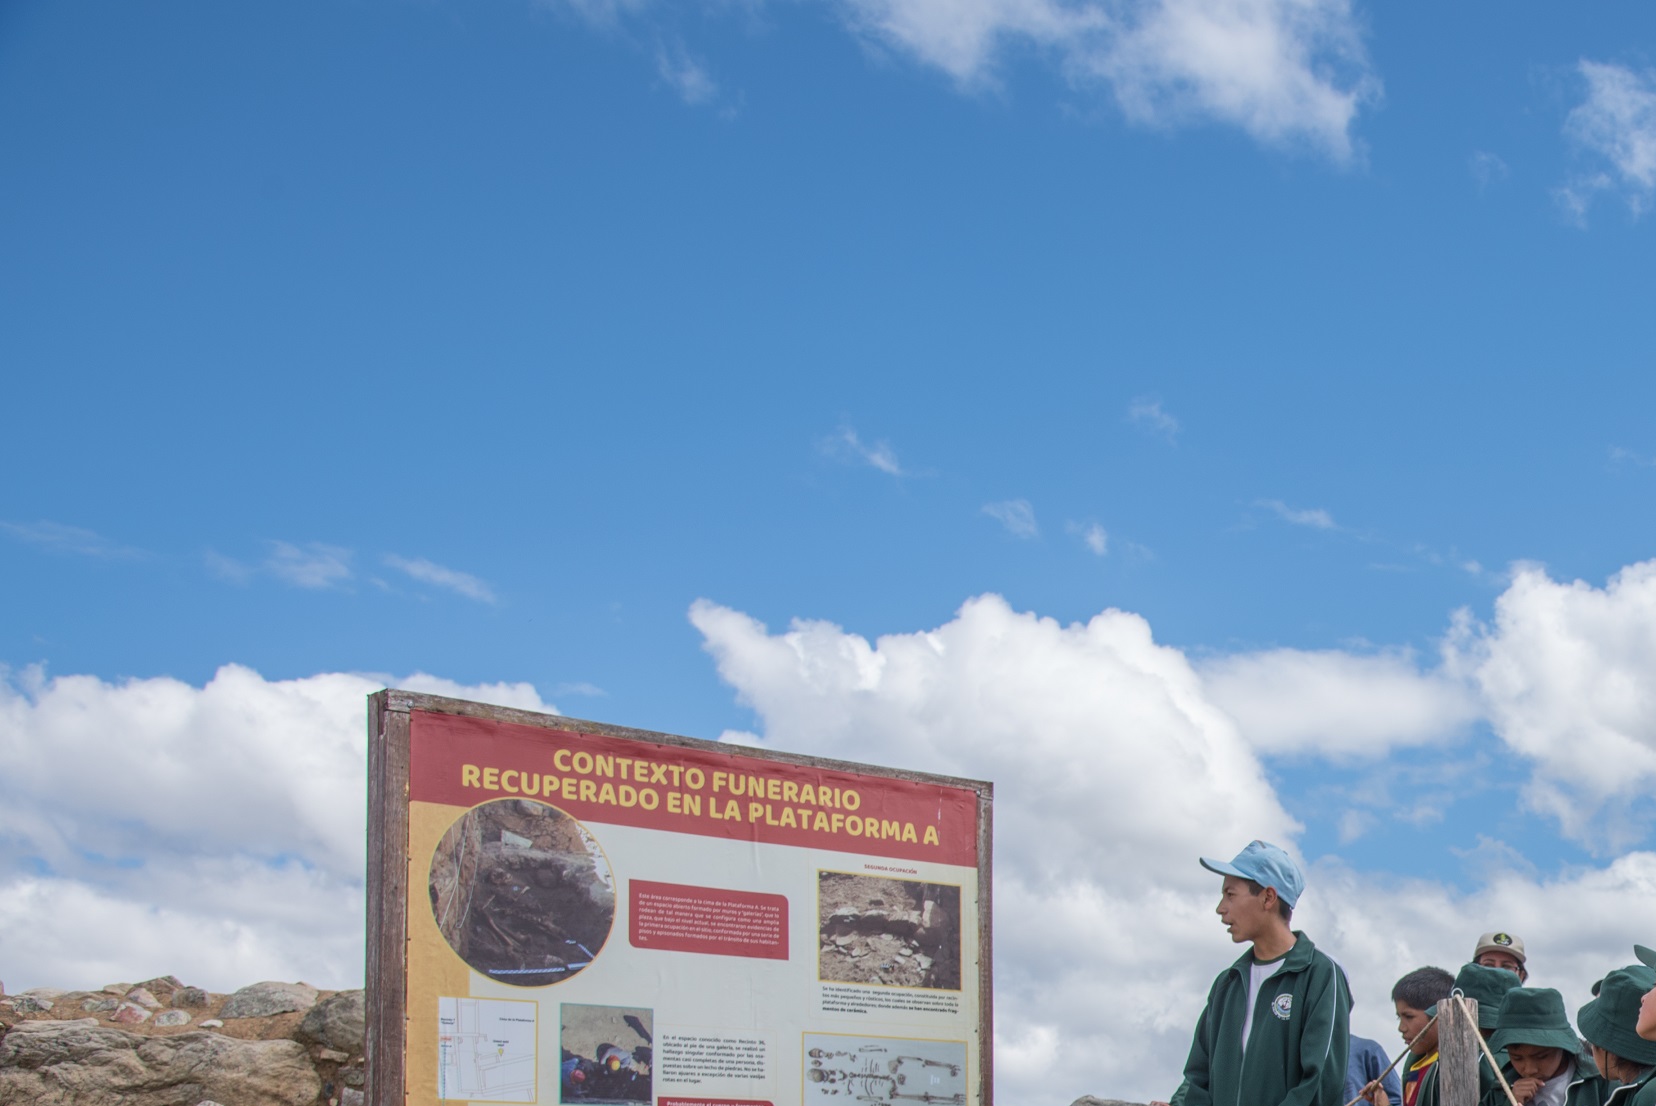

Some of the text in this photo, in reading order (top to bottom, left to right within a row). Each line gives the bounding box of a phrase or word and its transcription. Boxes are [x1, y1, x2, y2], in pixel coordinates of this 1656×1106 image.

[462, 764, 939, 846] RECUPERADO EN LA PLATAFORMA A
[554, 748, 861, 810] CONTEXTO FUNERARIO
[889, 866, 917, 875] OCUPACIÓN
